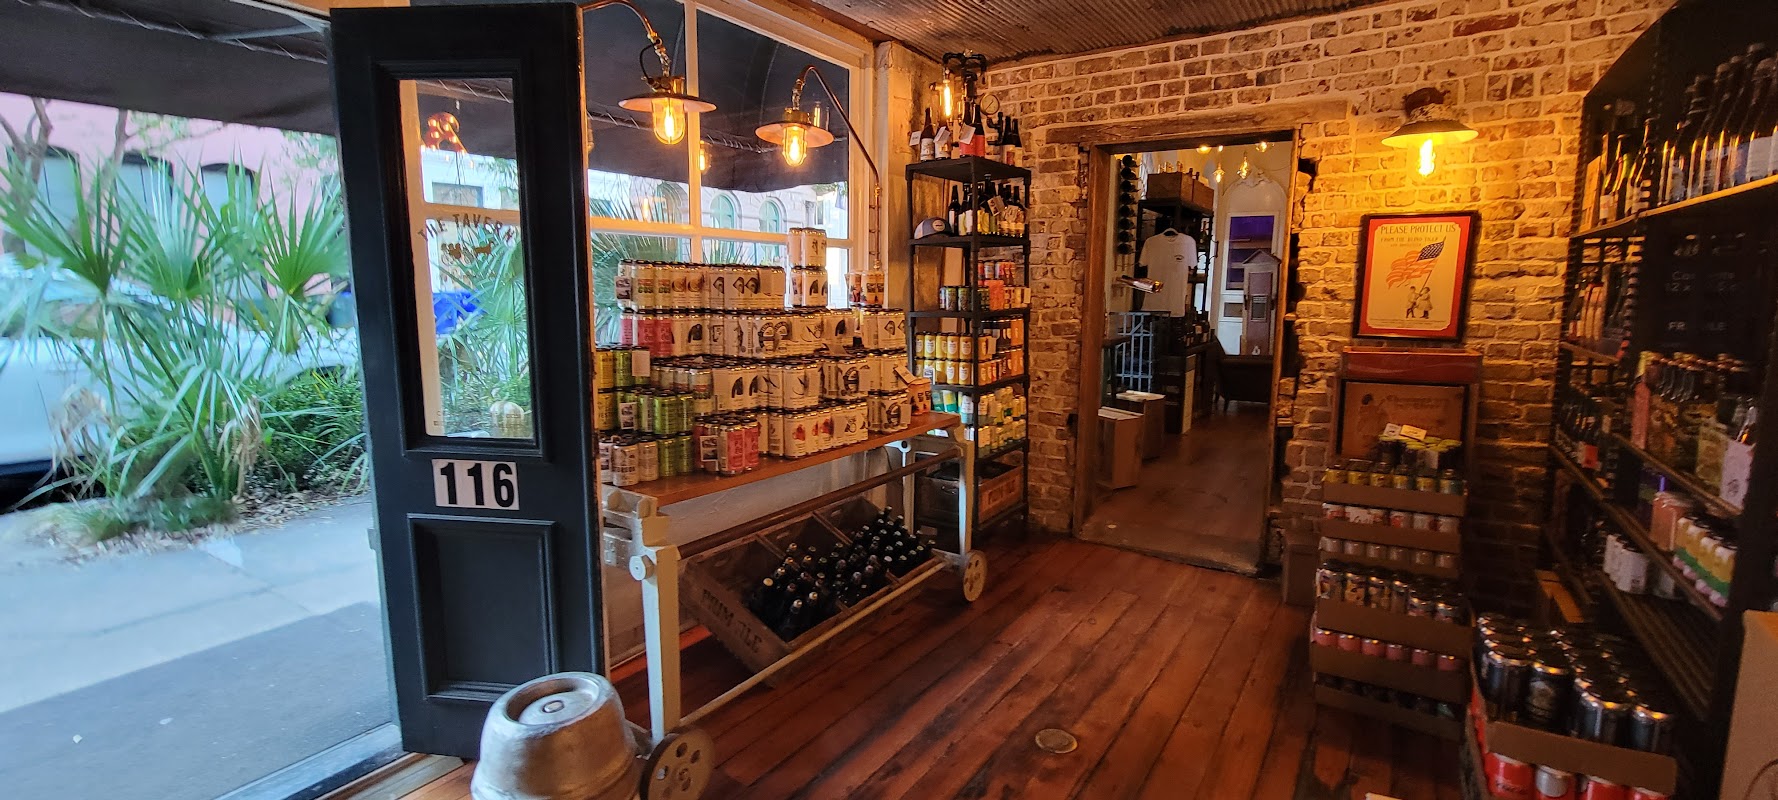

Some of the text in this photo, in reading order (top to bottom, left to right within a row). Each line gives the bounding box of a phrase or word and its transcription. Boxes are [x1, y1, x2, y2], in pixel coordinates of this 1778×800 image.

[418, 213, 515, 242] THE TAVERN
[1380, 224, 1456, 234] PLEASE PROTECT US
[440, 462, 514, 508] 116
